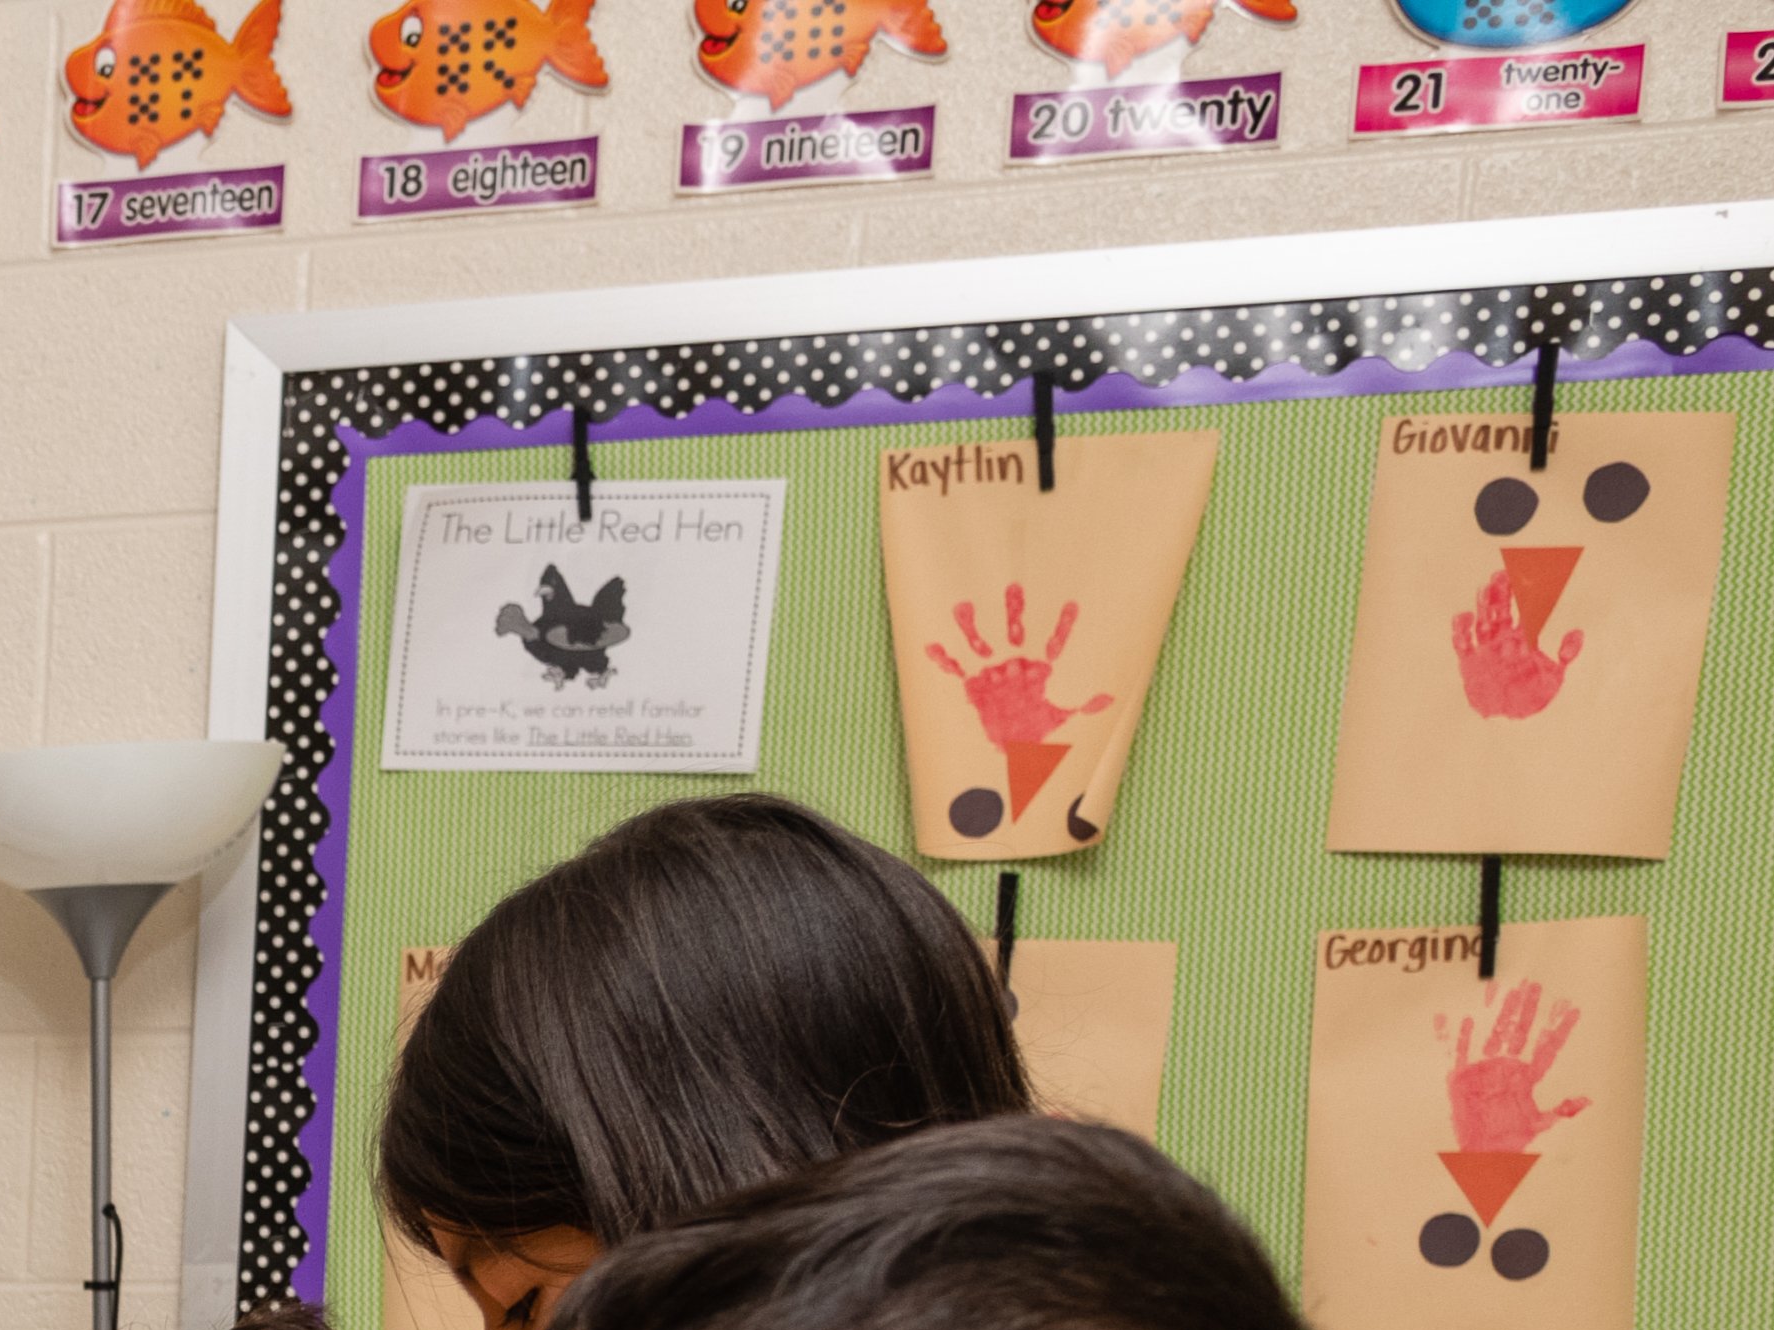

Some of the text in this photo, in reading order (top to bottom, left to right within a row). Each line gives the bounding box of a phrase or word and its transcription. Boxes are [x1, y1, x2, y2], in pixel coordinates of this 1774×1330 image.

[1394, 59, 1621, 114] 21 twenty-
[1526, 86, 1582, 112] one
[1031, 88, 1273, 143] 20 twenty
[701, 123, 921, 169] 19 nineteen
[383, 154, 588, 200] 18 eighteen
[73, 182, 274, 226] 17 seventeen
[887, 444, 1025, 494] Kaytlin
[441, 509, 744, 545] The Little Red Hen
[552, 704, 583, 718] can
[641, 699, 704, 718] familiar
[528, 726, 559, 746] The
[564, 727, 609, 746] Little
[615, 727, 650, 746] Red
